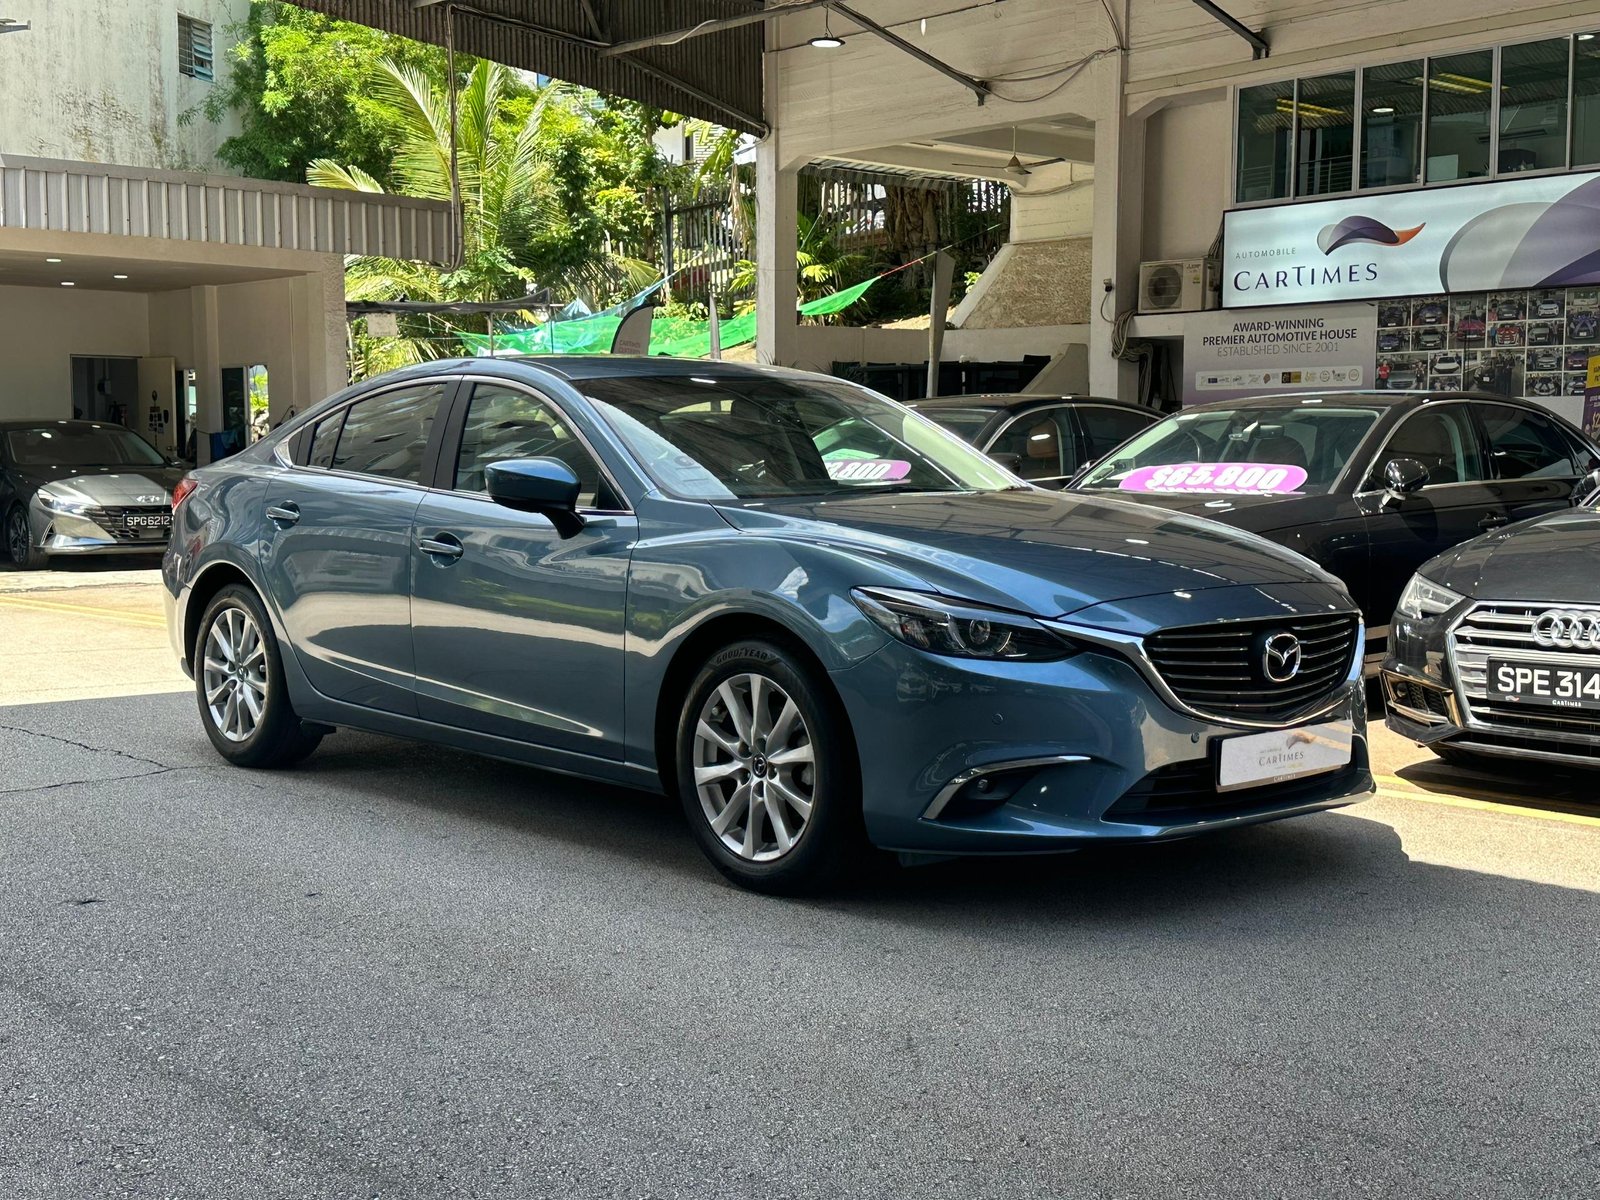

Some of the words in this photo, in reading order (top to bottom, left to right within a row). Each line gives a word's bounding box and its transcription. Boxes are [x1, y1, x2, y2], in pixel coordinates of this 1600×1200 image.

[1235, 247, 1297, 259] AUTOMOBILE
[1233, 262, 1378, 291] CARTIMES
[1232, 317, 1324, 333] AWARD-WINNING
[1203, 334, 1245, 346] PREMIER
[1247, 330, 1317, 345] AUTOMOTIVE
[1319, 328, 1358, 340] HOUSE
[1217, 344, 1280, 357] ESTABLISHED
[1283, 342, 1312, 354] SINCE
[1314, 341, 1340, 353] 2001
[126, 515, 170, 526] SPG6212
[1497, 666, 1551, 695] SPE
[1555, 670, 1600, 699] 314
[1552, 699, 1582, 708] CARTIMES
[1258, 751, 1305, 767] CARTIMES
